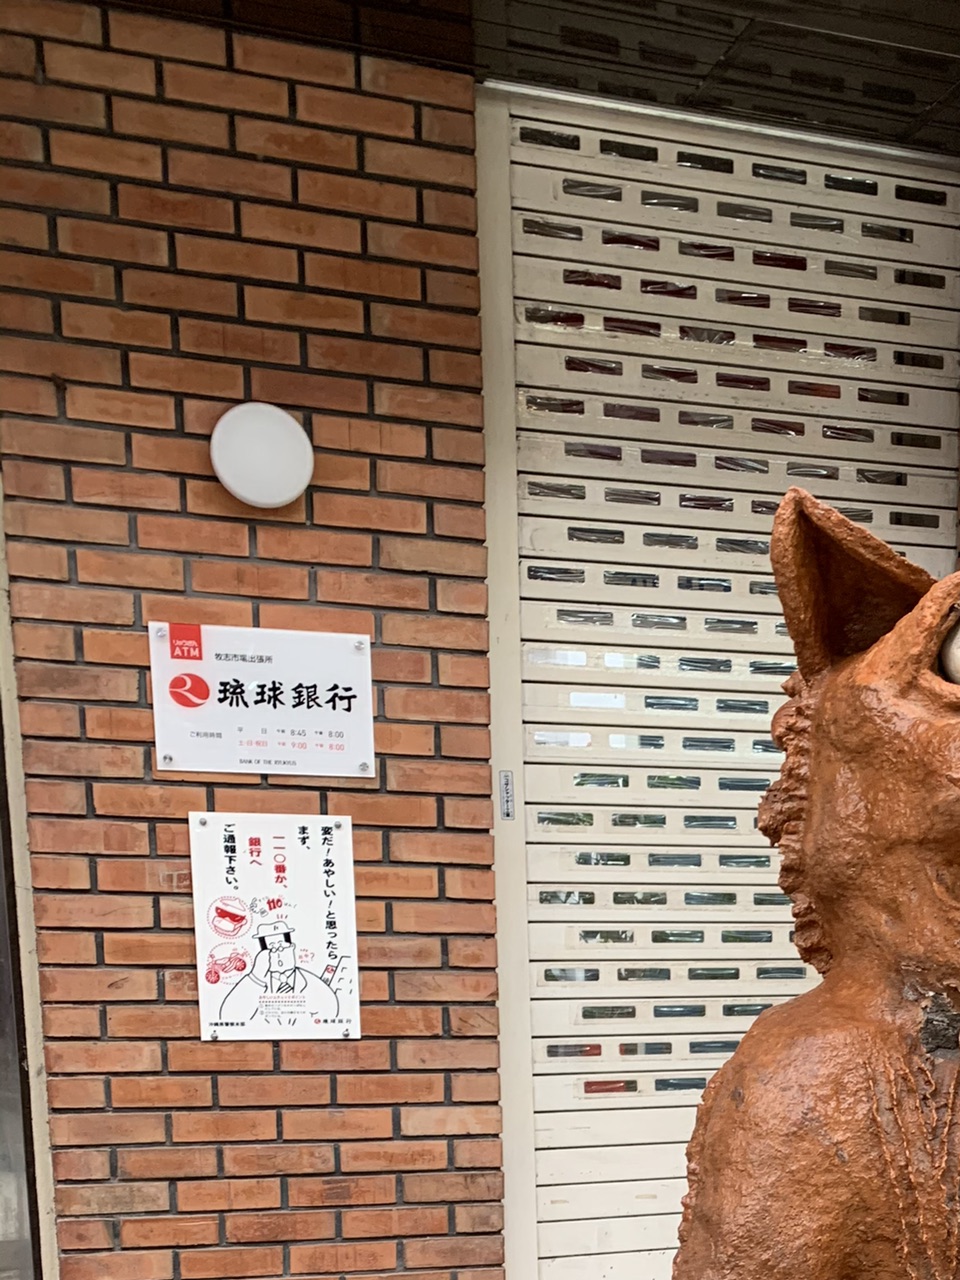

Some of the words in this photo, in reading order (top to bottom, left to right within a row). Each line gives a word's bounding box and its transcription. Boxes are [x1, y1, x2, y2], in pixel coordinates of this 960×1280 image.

[173, 646, 200, 657] ATM
[214, 652, 273, 664] 牧志市場出張所
[217, 678, 358, 713] 琉球銀行
[290, 729, 307, 737] 8:45
[328, 731, 345, 739] 8:00
[291, 741, 308, 750] 9:00
[328, 743, 345, 751] 8:00
[222, 823, 239, 890] ご通報下さい。
[248, 836, 263, 867] 銀行へ
[266, 898, 283, 911] 110
